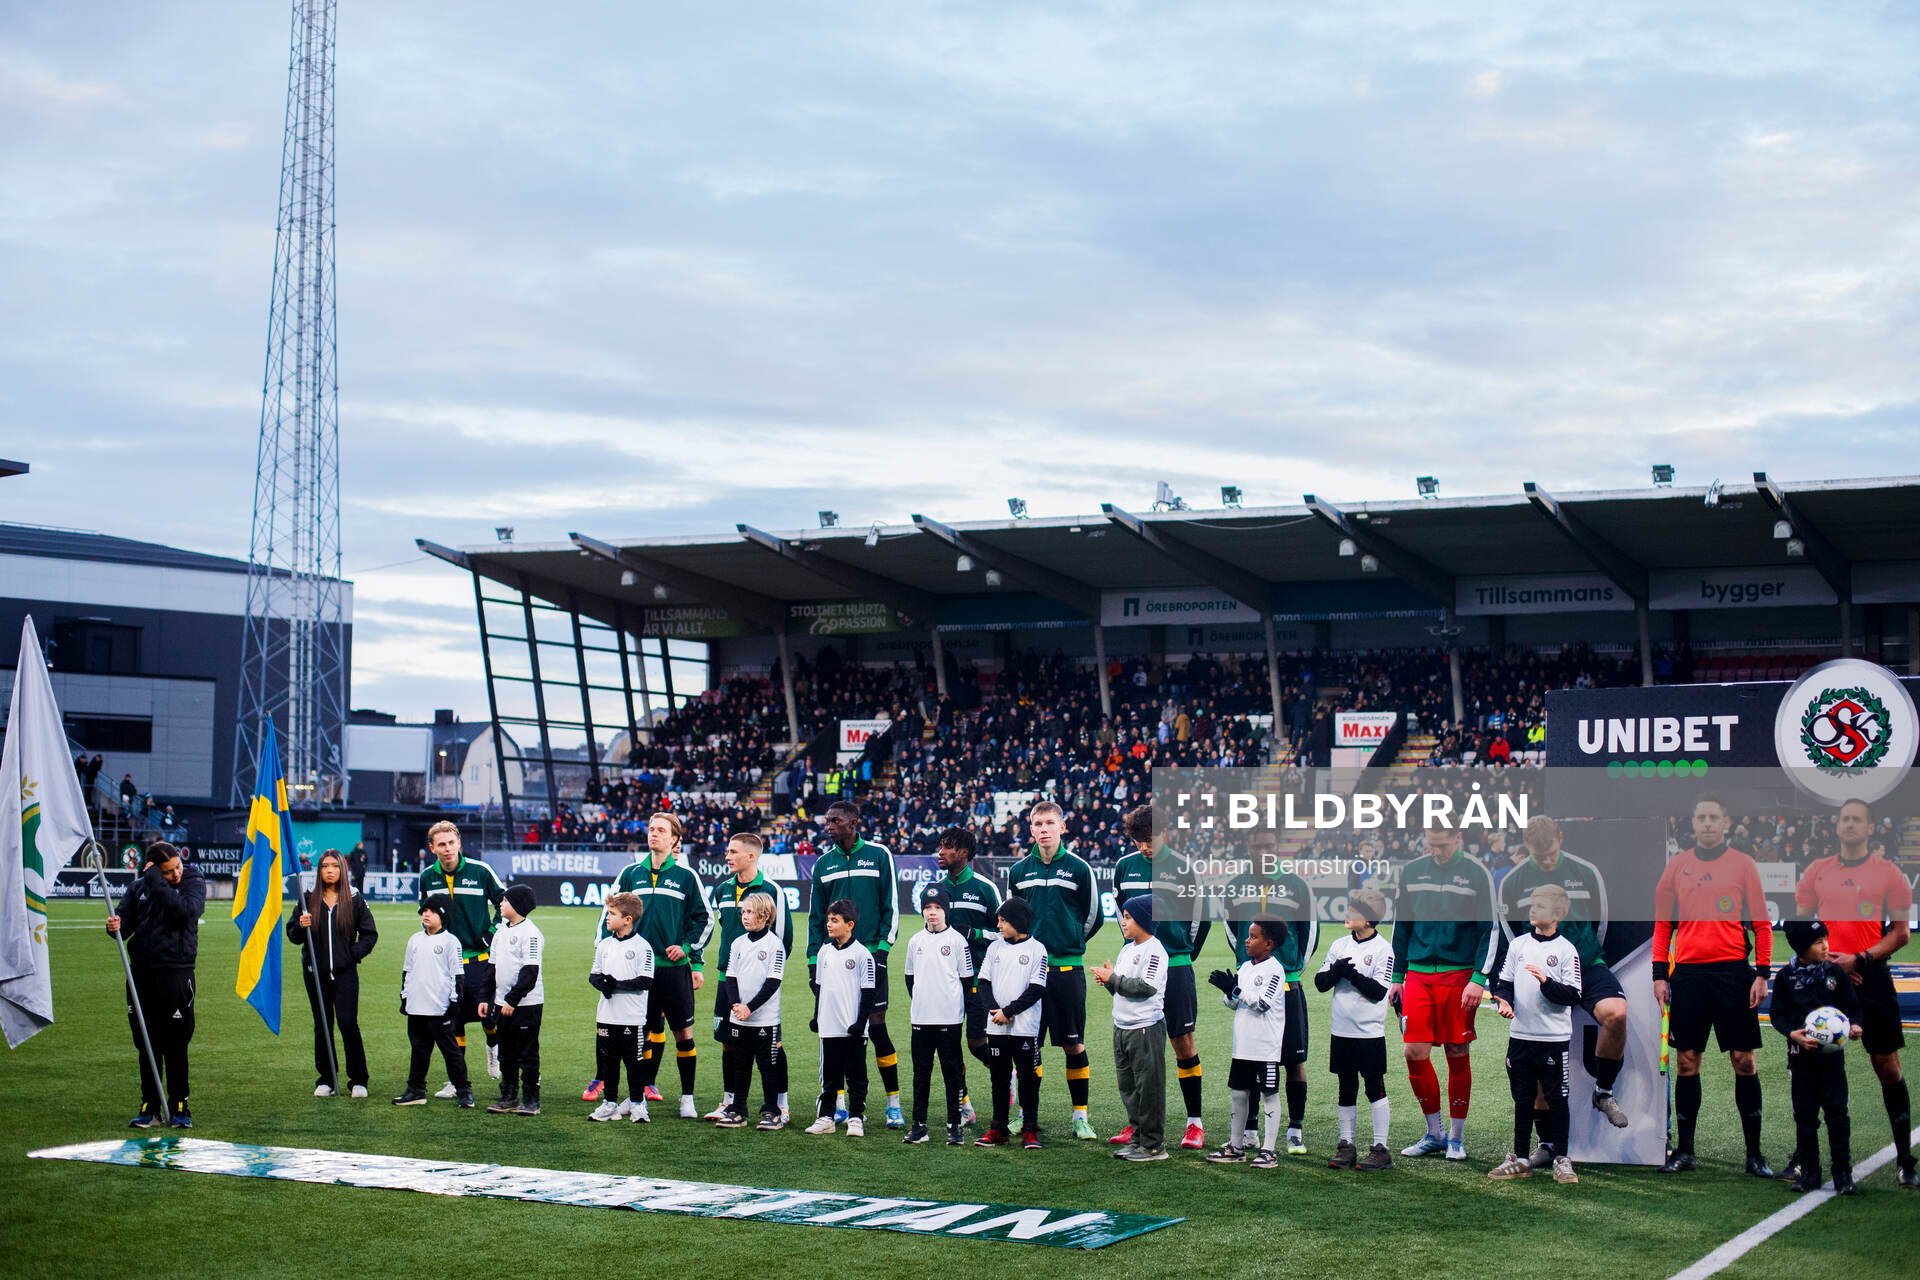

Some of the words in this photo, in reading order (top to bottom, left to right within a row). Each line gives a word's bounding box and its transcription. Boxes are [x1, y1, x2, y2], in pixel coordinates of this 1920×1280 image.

[1475, 585, 1614, 605] Tillsammans
[1701, 579, 1785, 603] bygger
[1146, 600, 1237, 613] ÖREBROPORTEN
[838, 616, 887, 629] PASSION
[1209, 629, 1297, 642] ÖREBROPOTEN
[847, 729, 870, 743] MA
[1577, 715, 1740, 755] UNIBET
[990, 1047, 1001, 1057] TB
